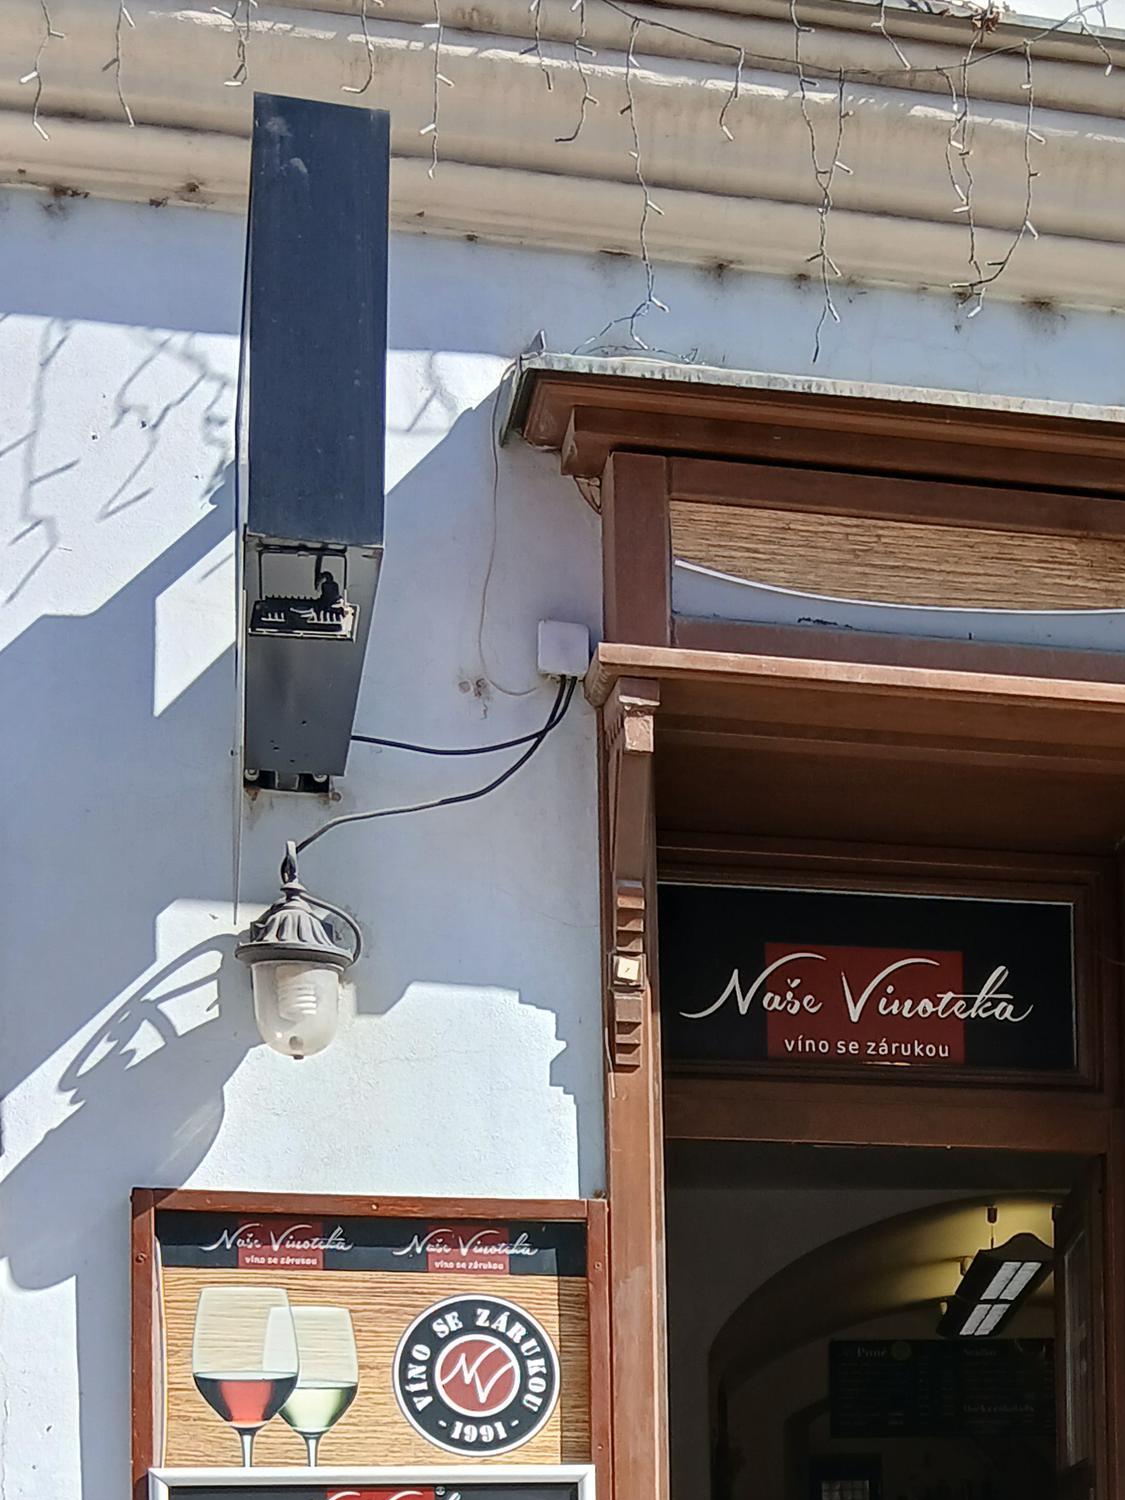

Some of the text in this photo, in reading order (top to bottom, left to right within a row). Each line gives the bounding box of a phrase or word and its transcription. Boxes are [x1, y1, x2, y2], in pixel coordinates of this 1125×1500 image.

[679, 952, 1033, 1022] Naše Vinoteka
[784, 1035, 950, 1057] víno se zárukou
[199, 1223, 353, 1252] Naše Vinoteka
[392, 1228, 537, 1256] Naše Vinoteka
[405, 1308, 547, 1412] VÍNO SE ZÁRUKOU
